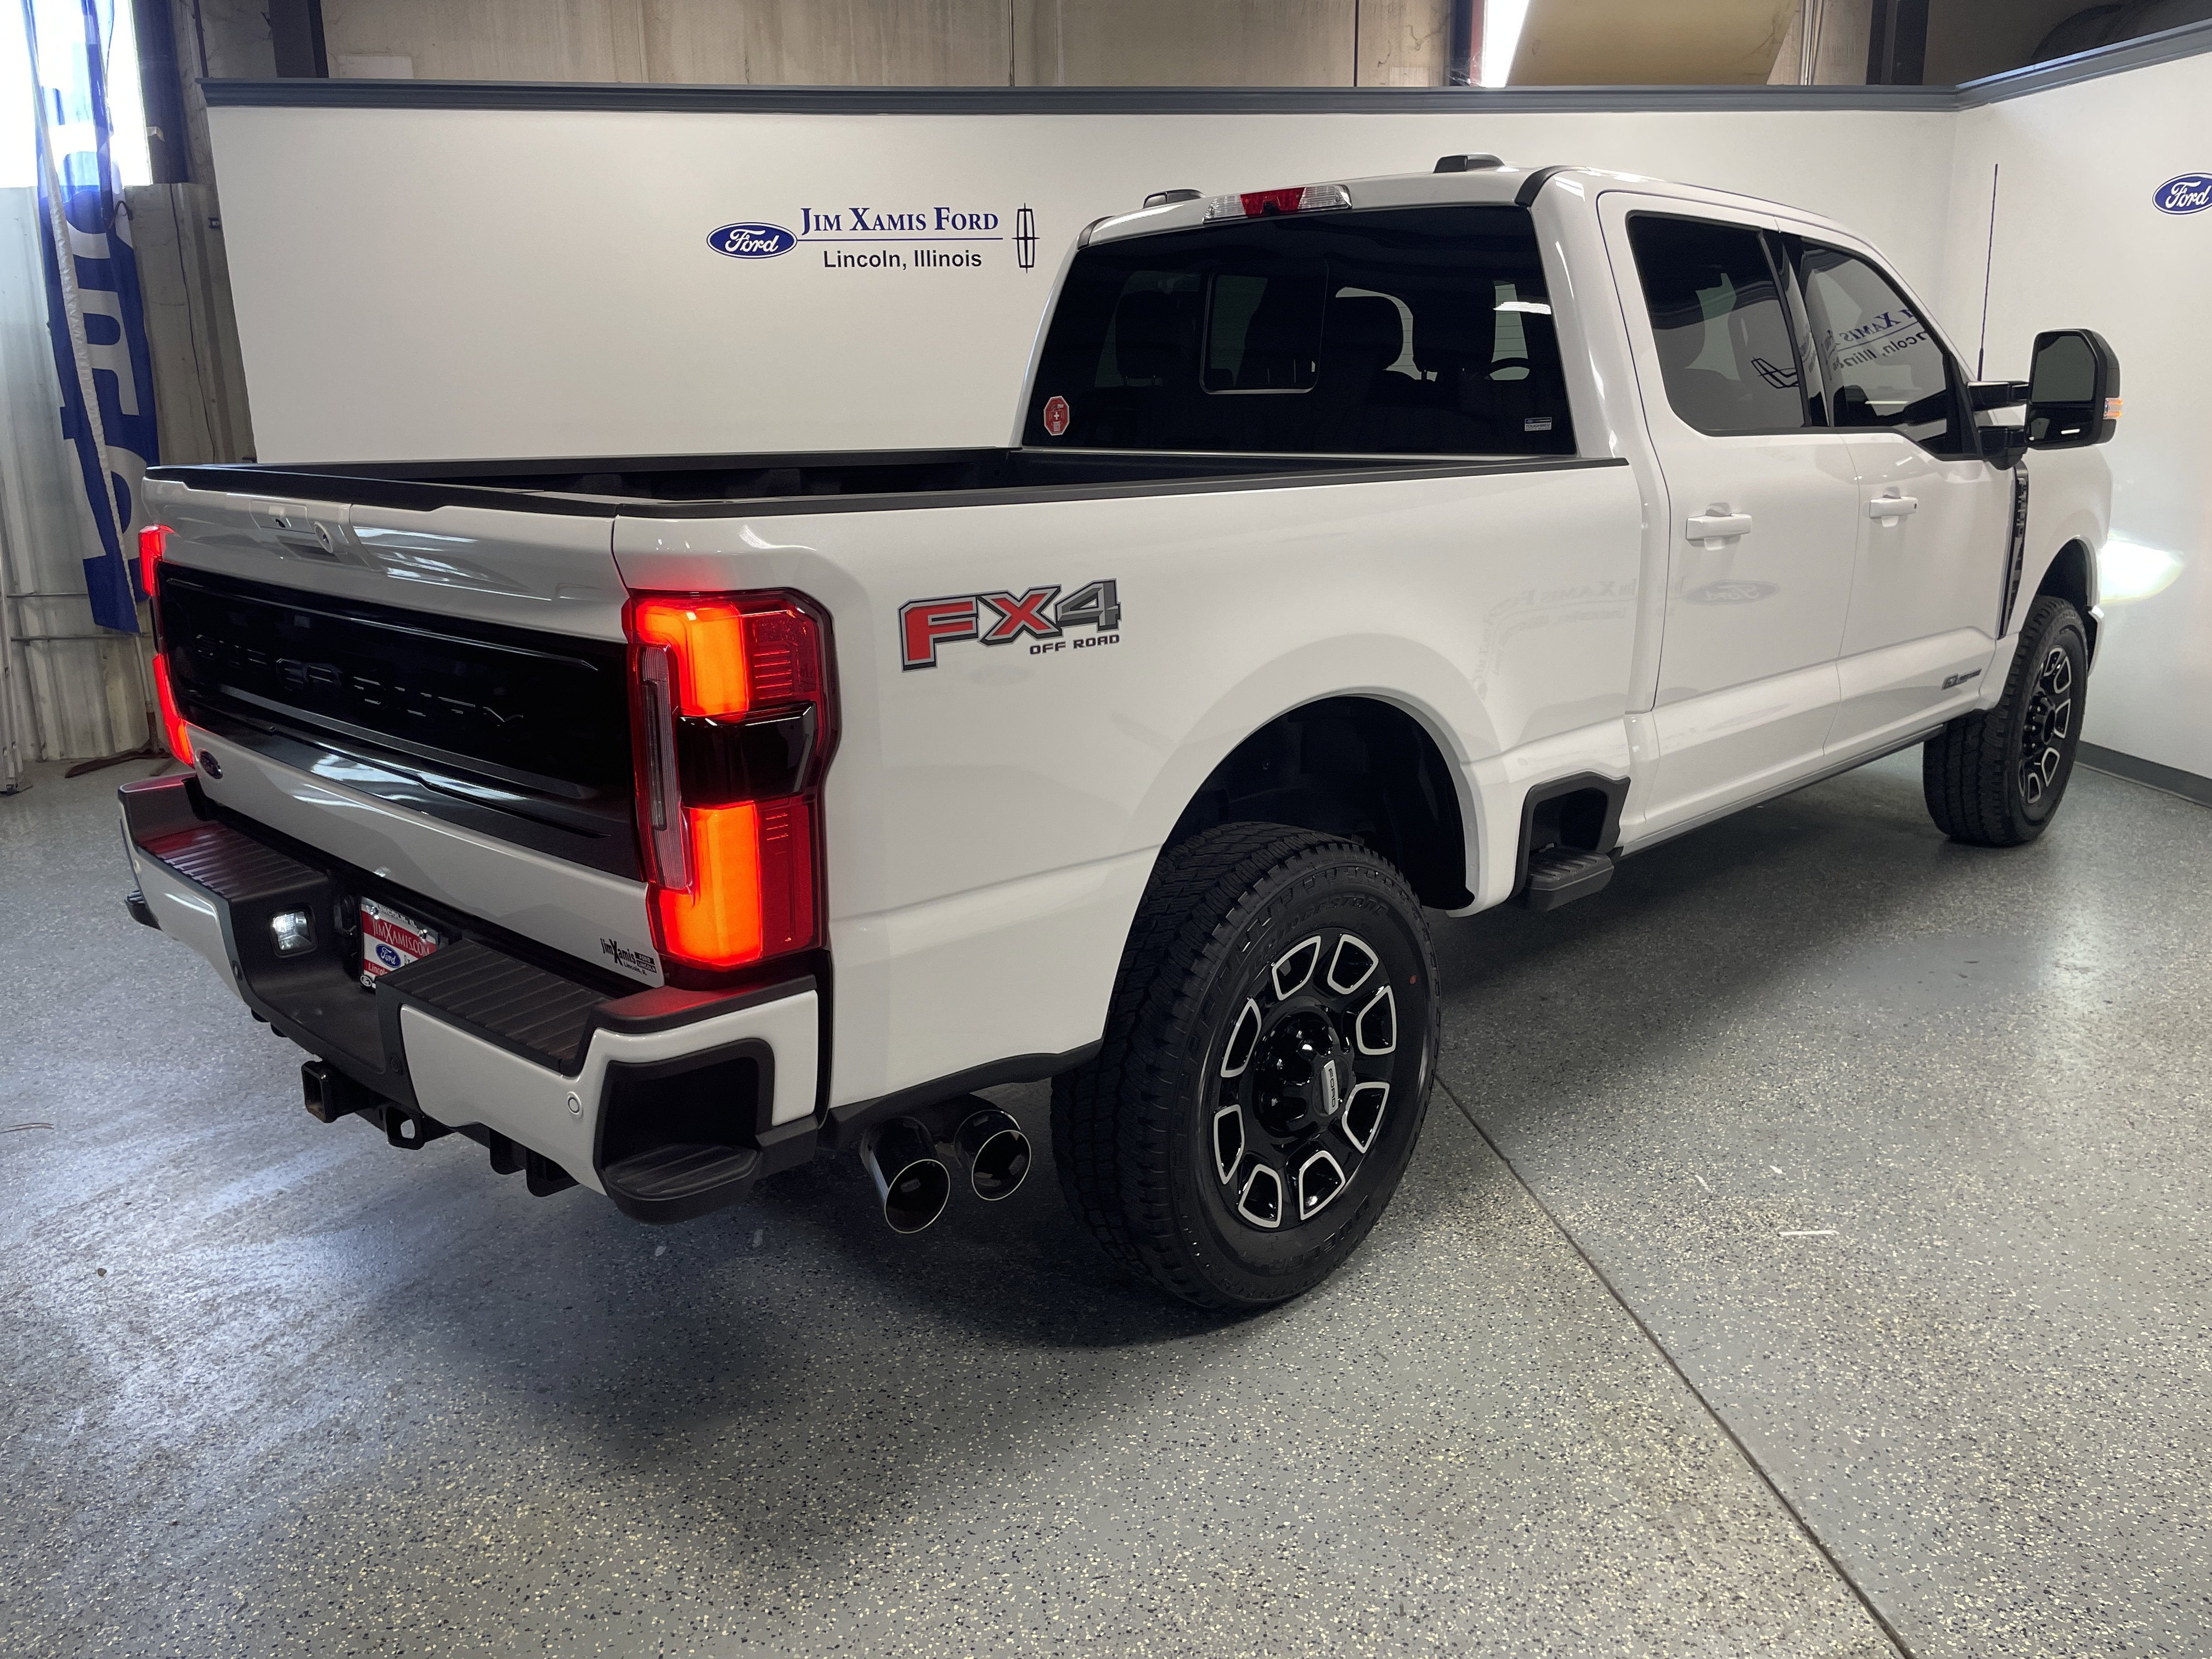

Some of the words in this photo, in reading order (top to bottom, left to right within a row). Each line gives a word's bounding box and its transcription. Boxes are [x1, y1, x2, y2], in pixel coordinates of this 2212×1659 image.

[2165, 180, 2212, 208] Ford
[849, 207, 927, 233] XAMIS
[933, 206, 999, 232] FORD
[724, 229, 779, 253] Ford
[823, 250, 907, 270] Lincoln,
[914, 249, 982, 267] Illinois
[897, 578, 1122, 673] FX4
[1029, 640, 1067, 655] OFF
[1073, 634, 1120, 650] ROAD
[380, 946, 397, 966] Ford
[368, 961, 388, 975] Lincol
